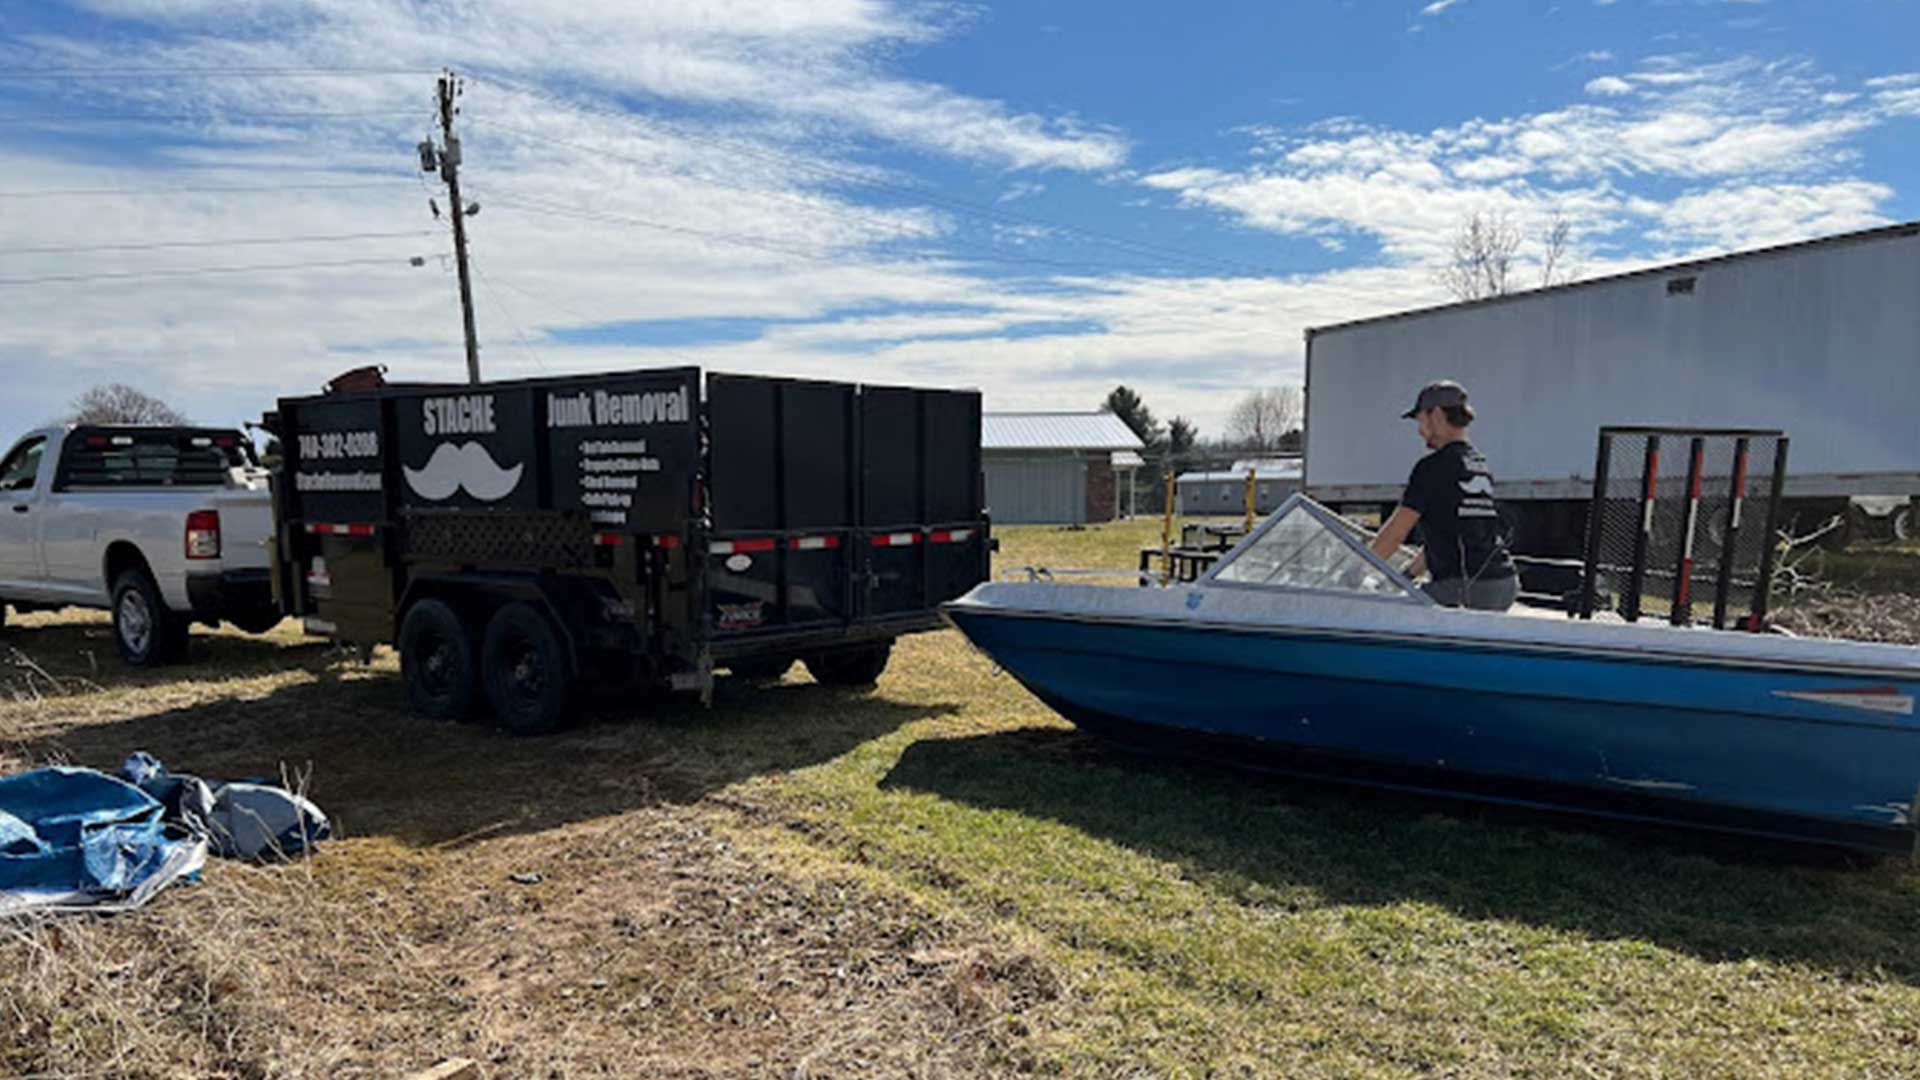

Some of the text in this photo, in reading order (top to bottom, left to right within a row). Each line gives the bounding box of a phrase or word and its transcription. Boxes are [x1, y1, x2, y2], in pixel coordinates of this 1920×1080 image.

[423, 395, 496, 436] STACHE
[547, 385, 689, 427] Junk Removal
